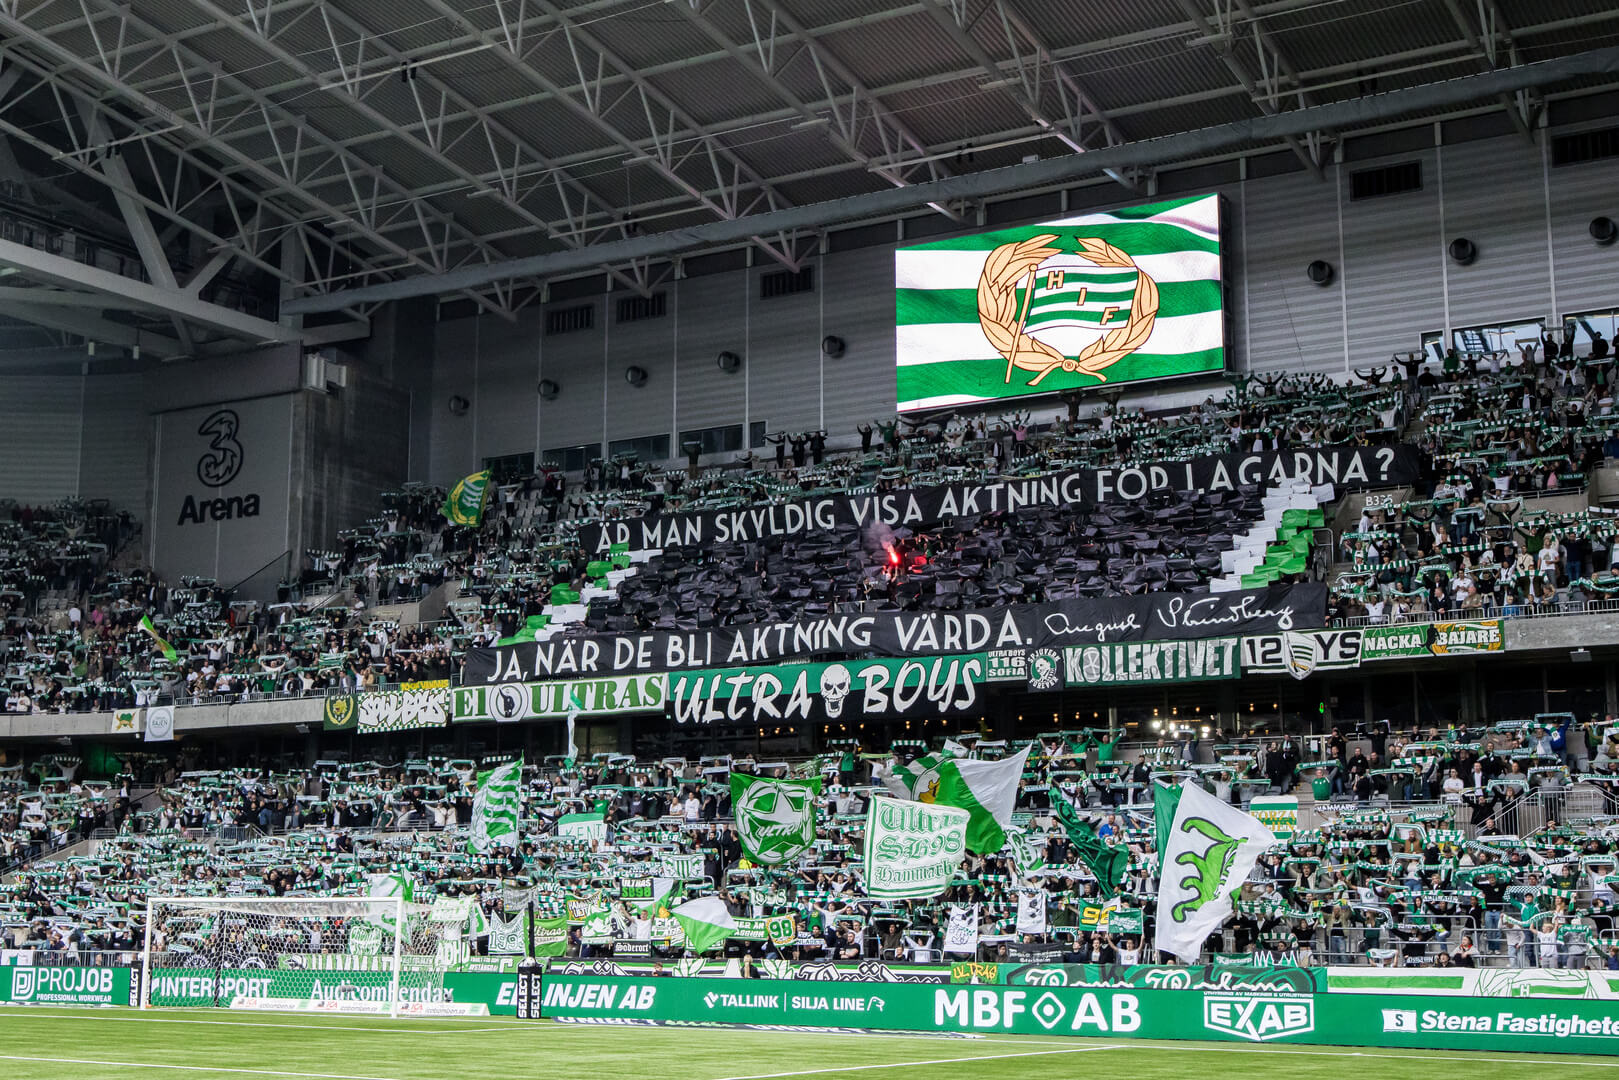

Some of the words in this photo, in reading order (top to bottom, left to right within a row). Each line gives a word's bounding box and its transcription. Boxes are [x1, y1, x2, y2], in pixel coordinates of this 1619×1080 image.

[177, 493, 260, 526] Arena
[642, 516, 702, 549] MAN
[714, 499, 835, 544] SKYLDIG
[850, 493, 923, 527] VISA
[937, 472, 1081, 518] AKTNING
[487, 648, 529, 682] JA,
[534, 638, 600, 676] NÄR
[613, 635, 654, 670] DE
[666, 631, 712, 669] BLI
[727, 615, 876, 663] AKTNING
[893, 608, 1034, 652] VÄRDA.
[1246, 637, 1283, 664] 12
[1313, 631, 1361, 660] YS
[1364, 633, 1423, 651] NACKA
[1436, 629, 1500, 646] BAJARE
[988, 656, 1026, 668] 116
[988, 667, 1026, 677] SOFIA
[1065, 637, 1238, 683] KOLLEKTIVET
[531, 676, 664, 714] ULTRAS
[673, 669, 814, 723] ULTRA
[857, 657, 982, 714] BOYS
[769, 919, 793, 939] 98
[615, 942, 649, 953] Söderort
[37, 967, 114, 992] PROJOB
[129, 967, 139, 1007] SELECT
[160, 976, 272, 998] INTERSPORT
[518, 973, 528, 1018] SELECT
[530, 973, 541, 1018] SELECT
[36, 993, 77, 1002] PROFESSIONAL
[78, 994, 112, 1002] WORKWEAR
[618, 985, 657, 1010] AB
[719, 994, 780, 1009] TALLINK
[791, 996, 829, 1011] SILJA
[833, 997, 865, 1012] LINE
[934, 988, 1027, 1029] MBF
[1071, 993, 1142, 1033] AB
[1209, 1000, 1308, 1038] EXAB
[1420, 1009, 1491, 1031] Stena
